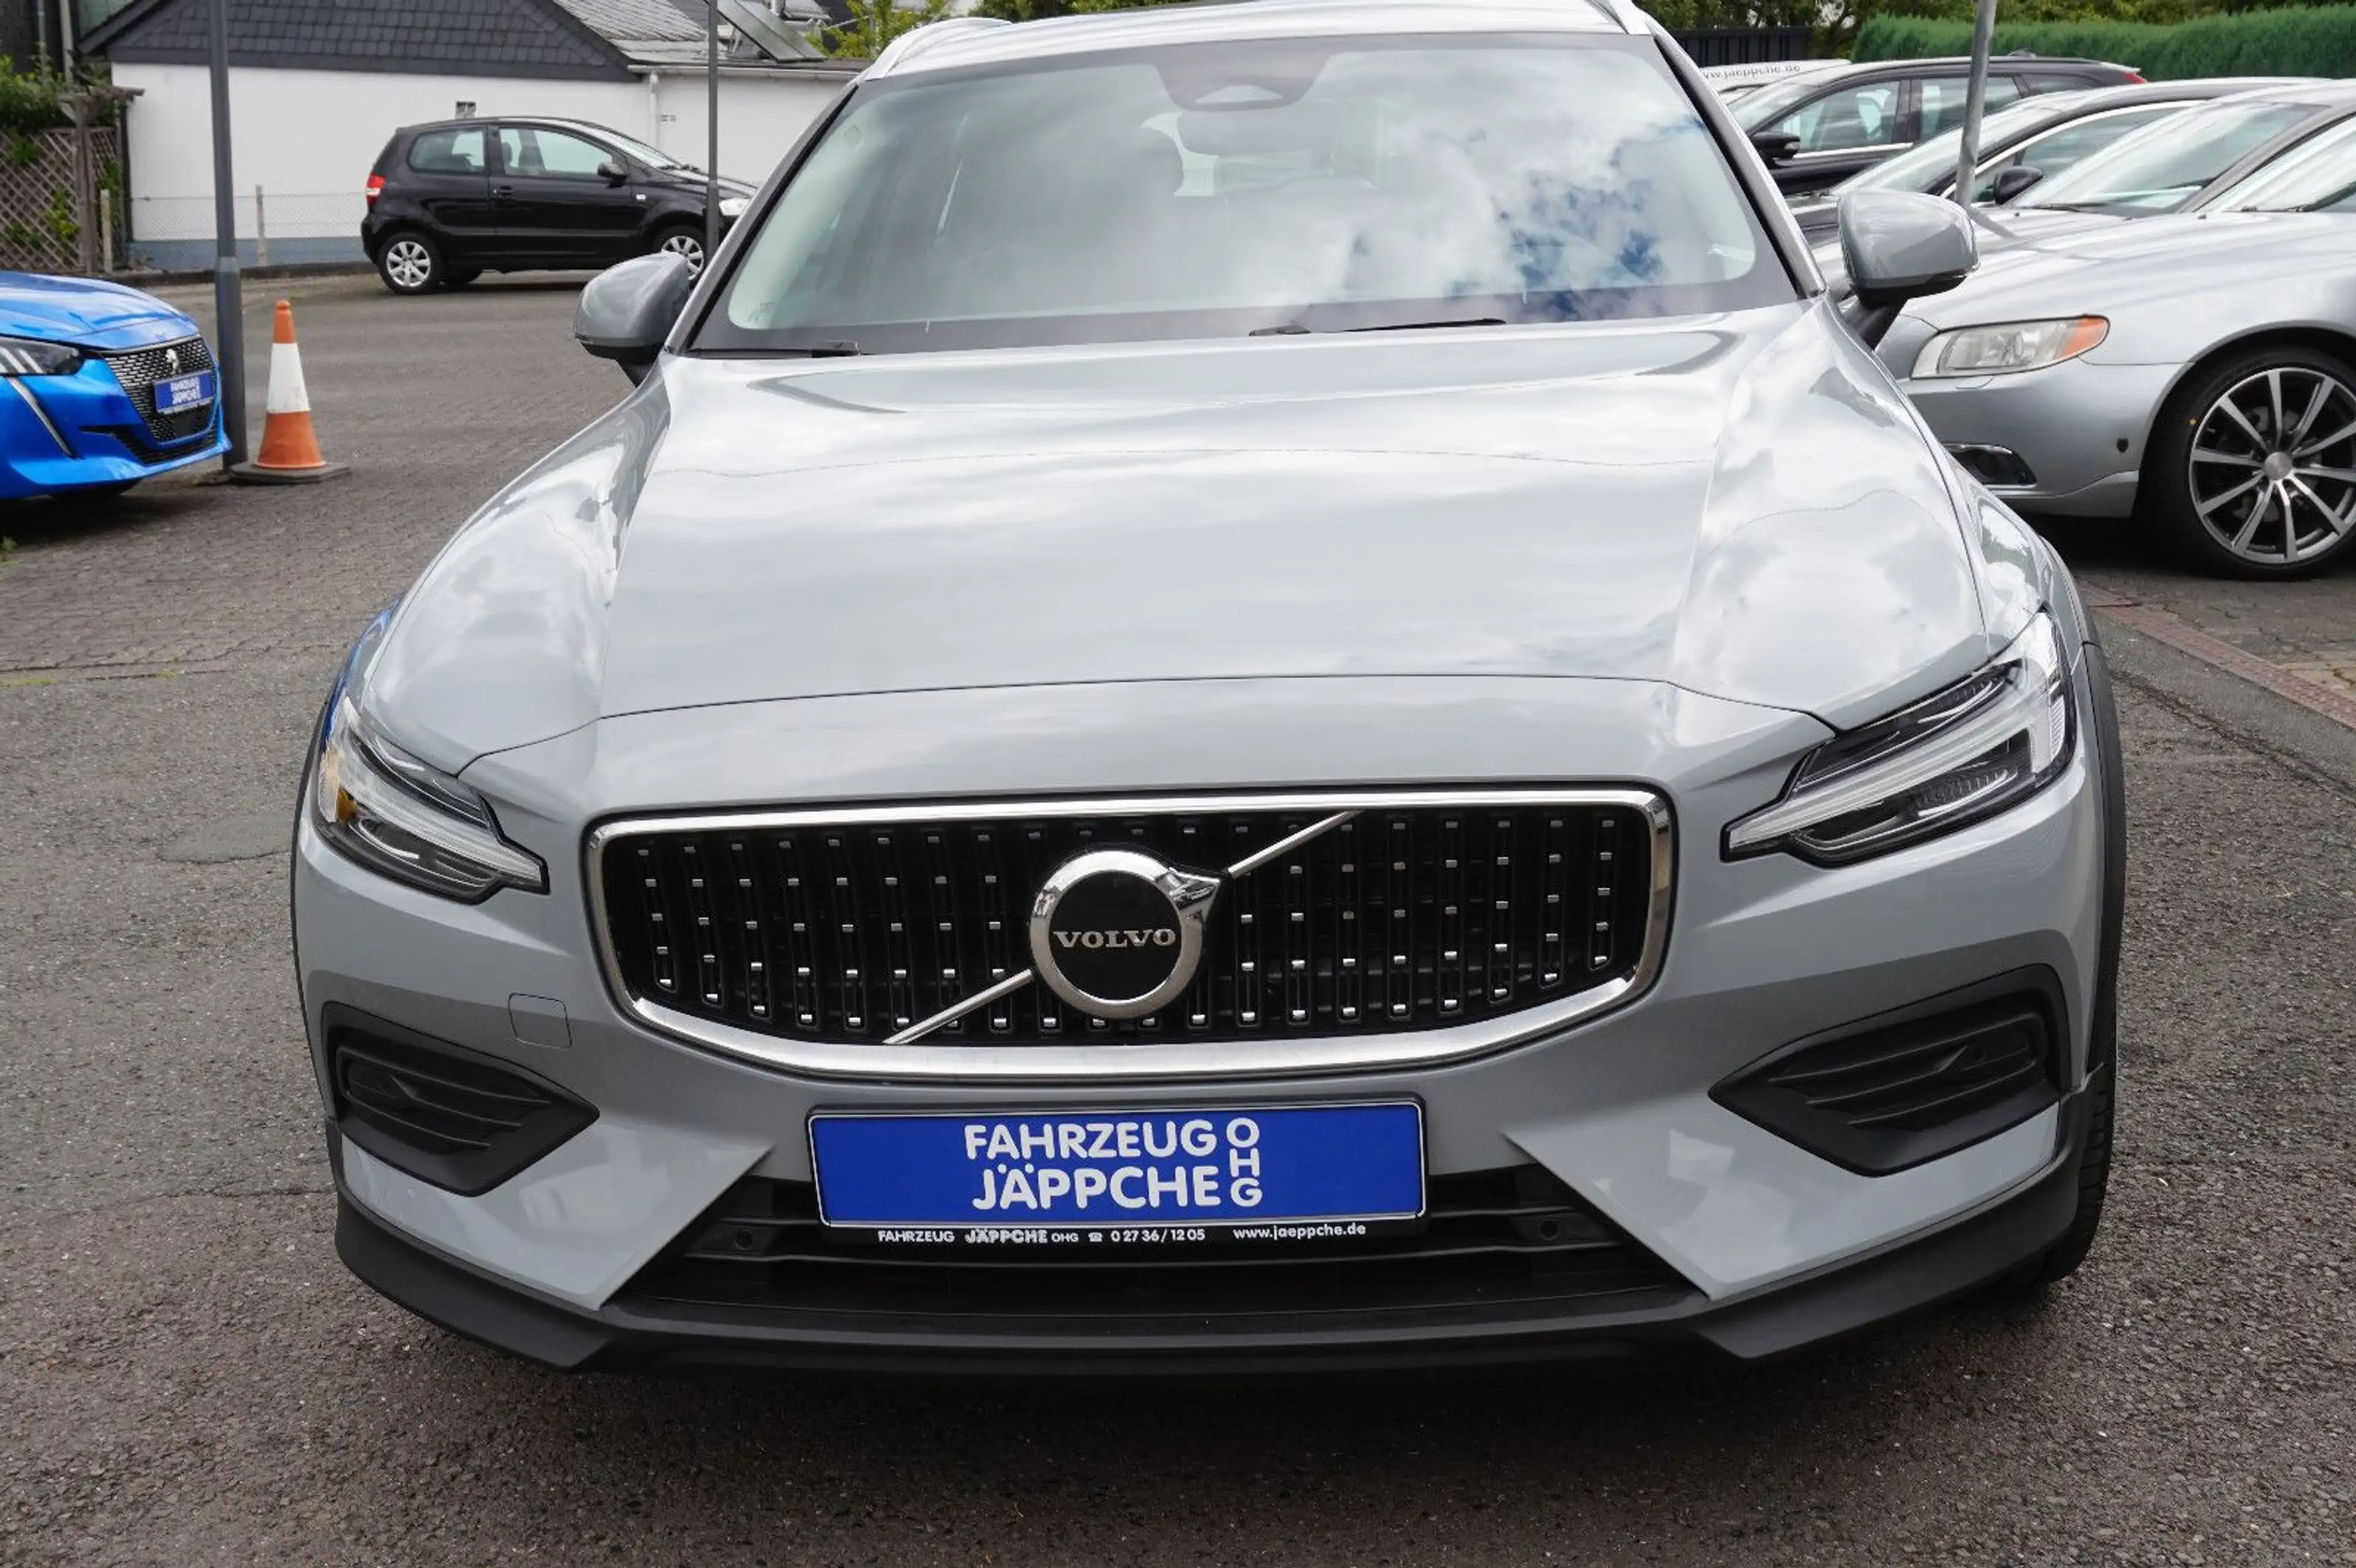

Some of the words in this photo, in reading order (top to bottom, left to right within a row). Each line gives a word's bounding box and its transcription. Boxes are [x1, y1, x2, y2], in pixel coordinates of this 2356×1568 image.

[1053, 928, 1176, 948] VOLVO
[964, 1118, 1218, 1160] FAHRZEUG
[1226, 1117, 1263, 1208] OHG
[972, 1163, 1222, 1210] JÄPPCHE
[877, 1230, 955, 1243] FAHRZEUG
[964, 1228, 1048, 1243] JÄPPCHE
[1051, 1232, 1079, 1243] OHG
[1233, 1222, 1366, 1240] www.jaeppche.de
